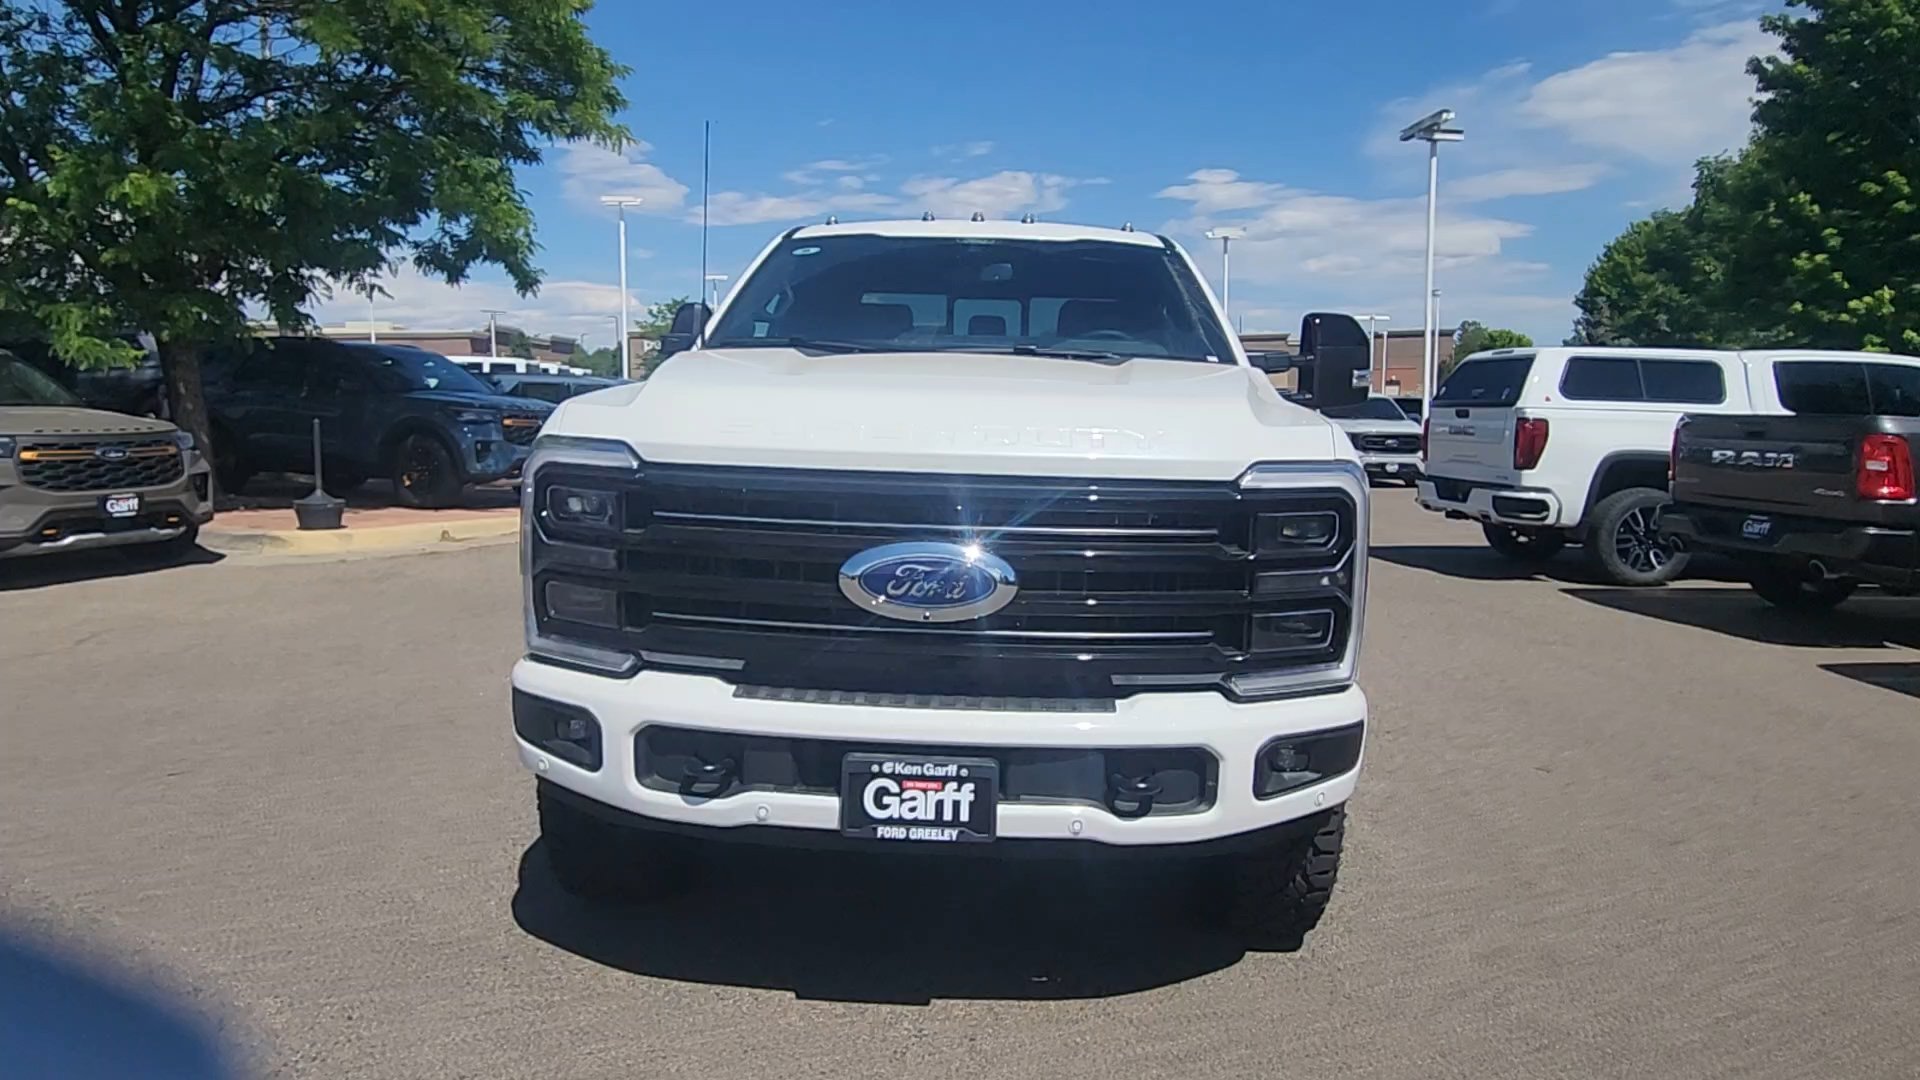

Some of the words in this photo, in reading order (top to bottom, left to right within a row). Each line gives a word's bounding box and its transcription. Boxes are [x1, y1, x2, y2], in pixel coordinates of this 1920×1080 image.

[1712, 451, 1794, 468] RAM
[106, 498, 139, 512] Garff
[1743, 520, 1771, 533] Garff
[886, 564, 966, 599] Ford
[895, 763, 922, 775] Ken
[923, 764, 957, 777] Garff
[863, 778, 975, 822] Garff
[877, 827, 906, 839] FORD
[909, 829, 958, 841] GREELEY
